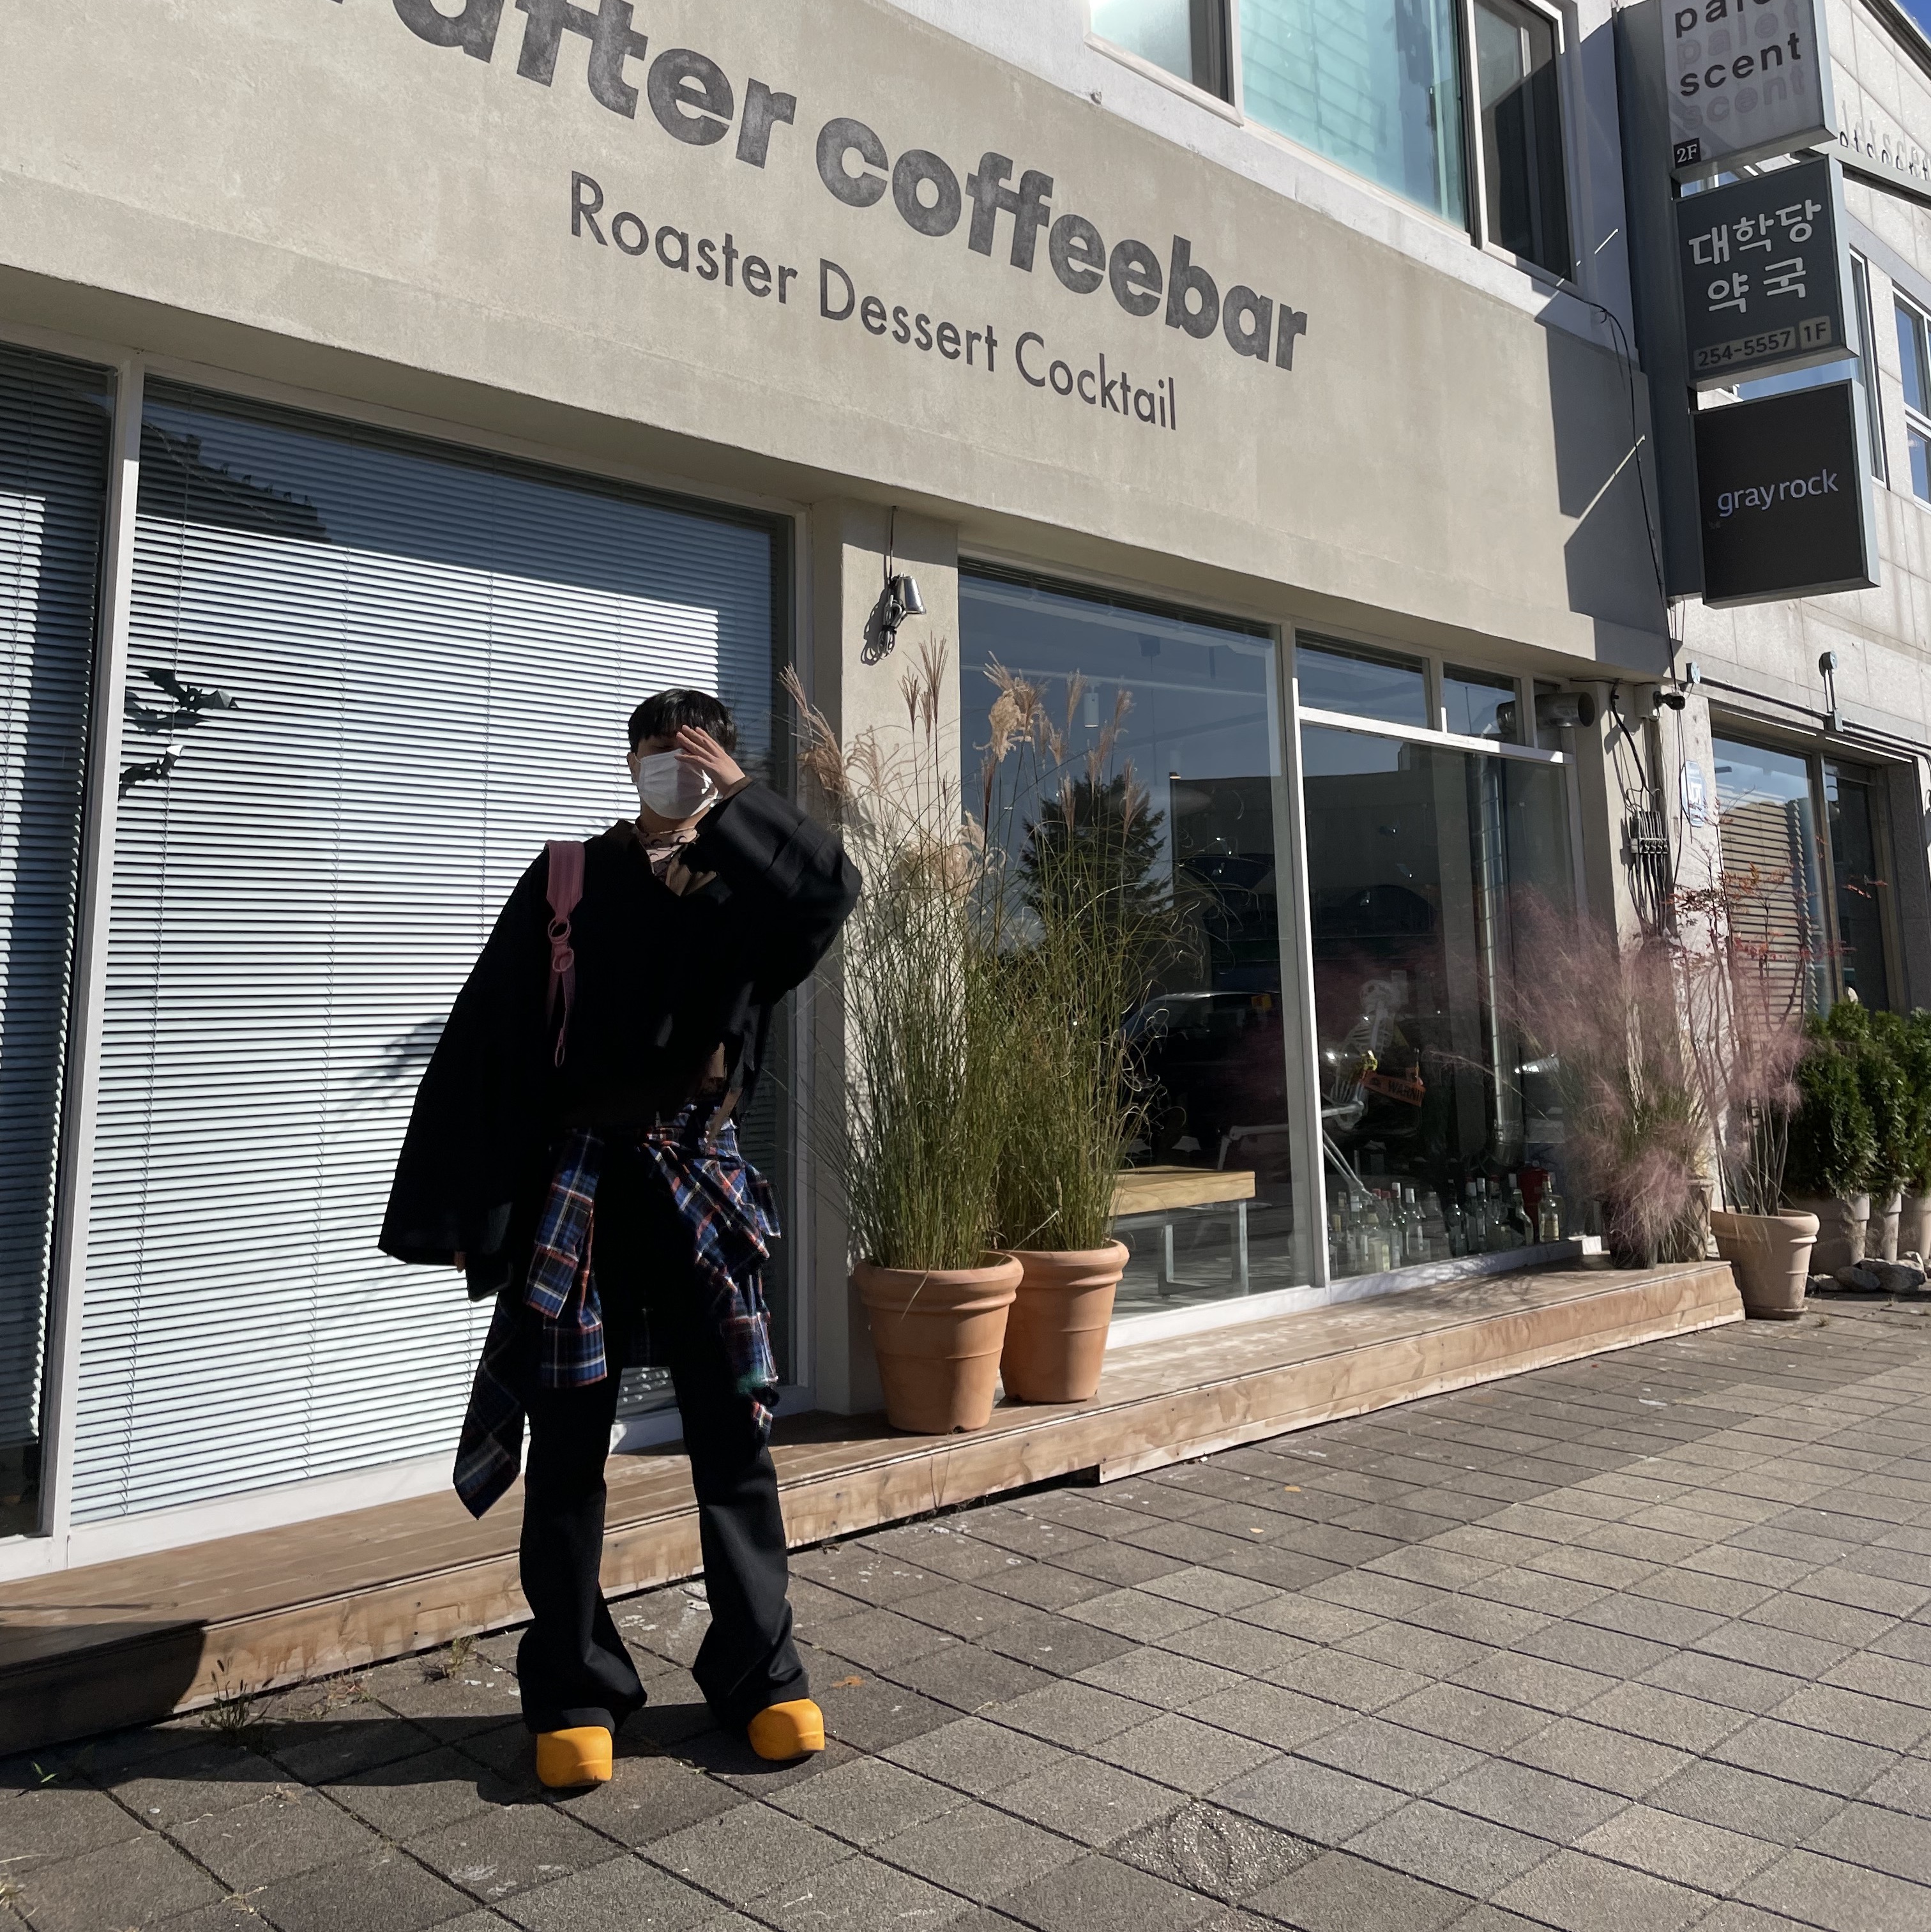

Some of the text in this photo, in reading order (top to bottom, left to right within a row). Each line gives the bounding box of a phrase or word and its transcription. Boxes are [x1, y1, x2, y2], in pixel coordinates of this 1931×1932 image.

[1675, 0, 1771, 38] pa
[1680, 33, 1801, 96] scent
[1676, 144, 1697, 164] 2F
[816, 118, 1308, 372] coffeebar
[1688, 199, 1822, 265] 대학당
[571, 170, 1177, 430] Roaster Dessert Cocktail
[1708, 257, 1806, 314] 약국
[1698, 322, 1826, 367] 254-5557 1F
[1718, 469, 1839, 517] grayrock
